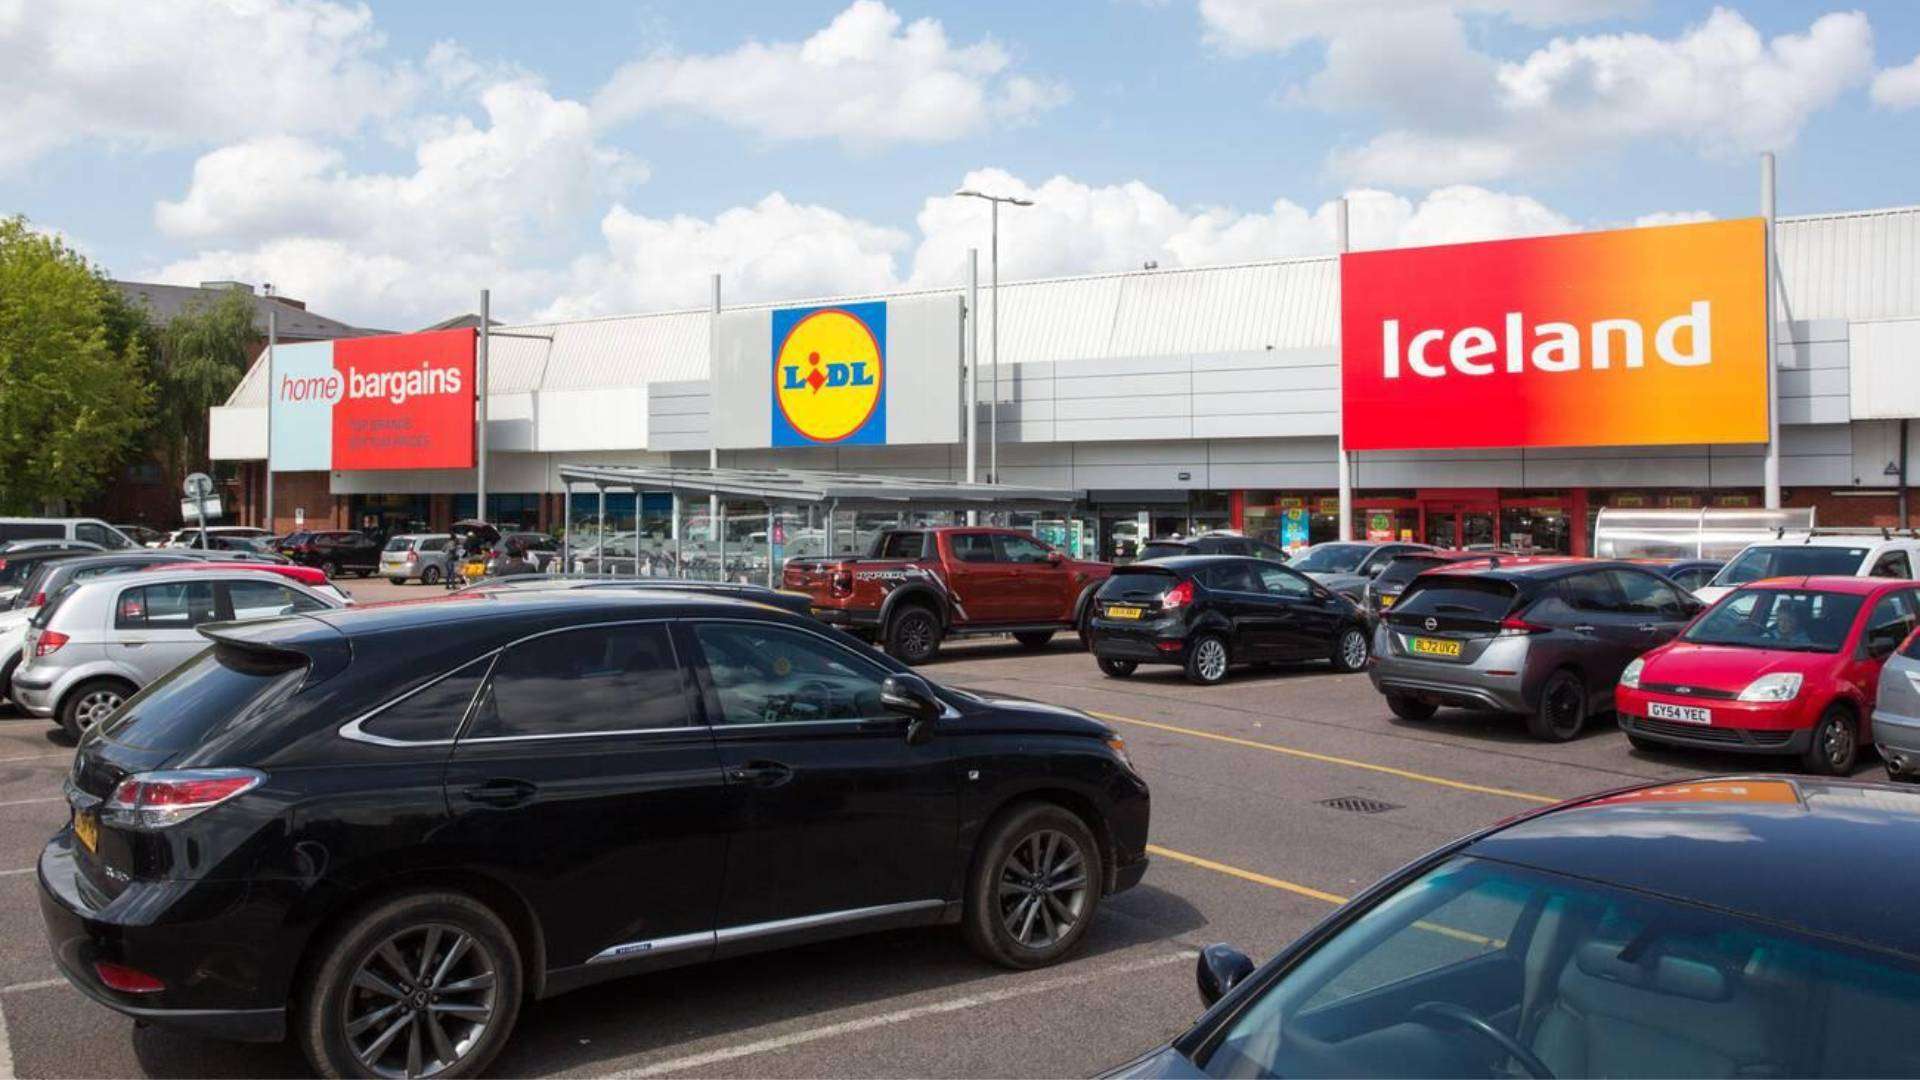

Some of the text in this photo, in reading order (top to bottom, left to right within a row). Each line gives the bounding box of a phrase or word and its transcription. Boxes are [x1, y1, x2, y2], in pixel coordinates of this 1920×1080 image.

[1382, 300, 1712, 379] Iceland
[280, 361, 462, 404] home bargains
[1652, 704, 1707, 722] GY54 YEC
